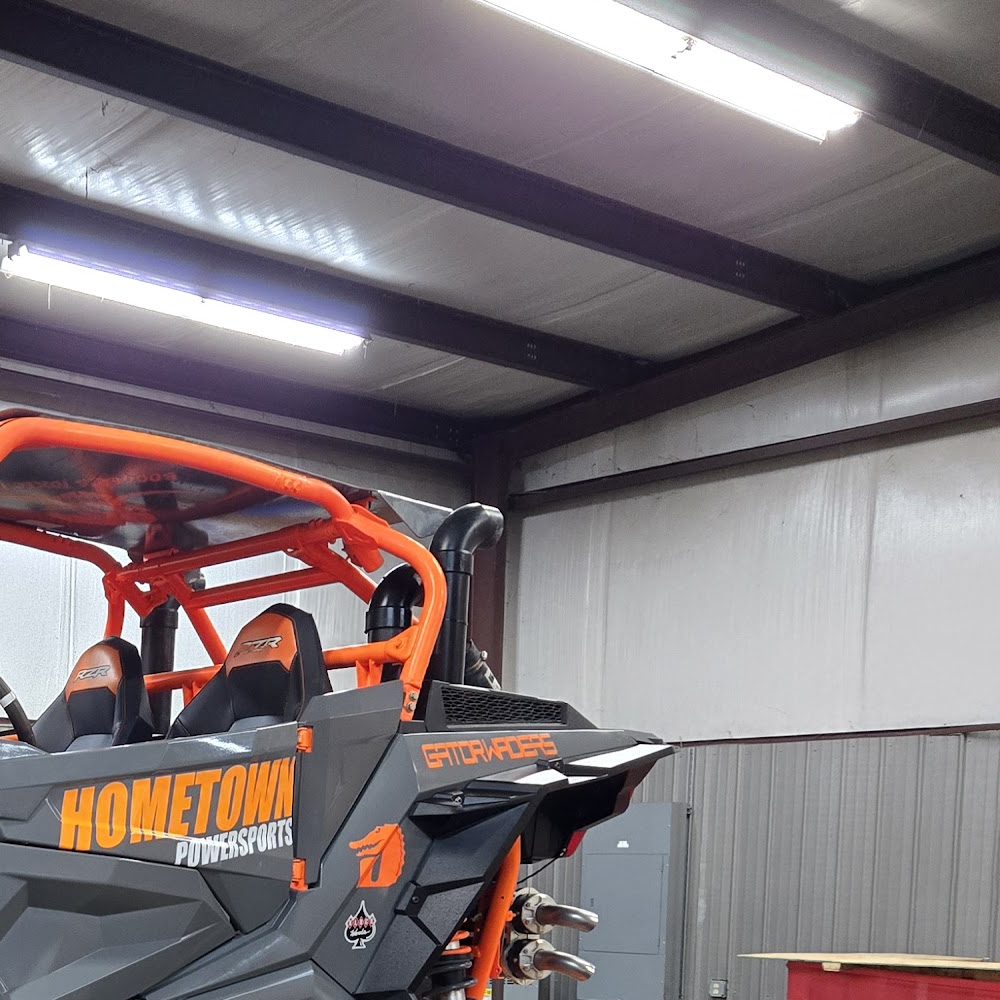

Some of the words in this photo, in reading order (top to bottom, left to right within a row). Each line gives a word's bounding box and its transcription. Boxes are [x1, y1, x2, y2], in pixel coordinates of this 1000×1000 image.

[73, 665, 111, 683] RZR
[421, 732, 558, 769] GATORWADERS
[58, 755, 296, 851] HOMETOWN
[174, 816, 293, 868] POWERSPORTS
